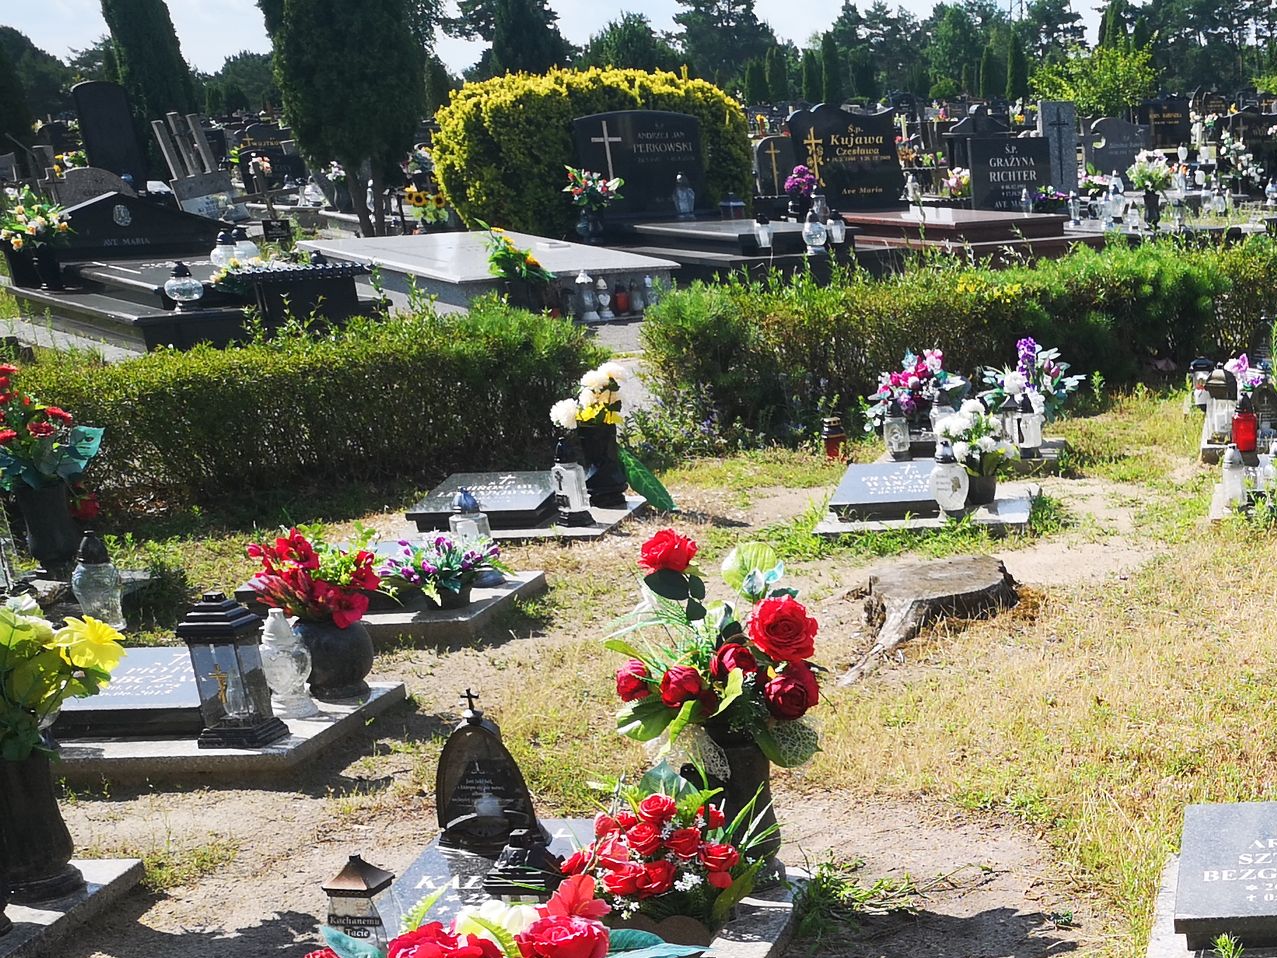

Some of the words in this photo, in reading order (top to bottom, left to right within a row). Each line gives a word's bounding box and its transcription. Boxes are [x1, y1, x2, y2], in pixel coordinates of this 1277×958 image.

[830, 134, 884, 147] Kujawa
[633, 142, 693, 153] PERKOWSKI
[836, 146, 880, 156] Czesława
[989, 155, 1035, 168] GRAŻYNA
[989, 170, 1037, 182] RICHTER
[842, 187, 856, 195] Ave
[859, 185, 883, 194] Maria
[347, 928, 369, 938] Tacie
